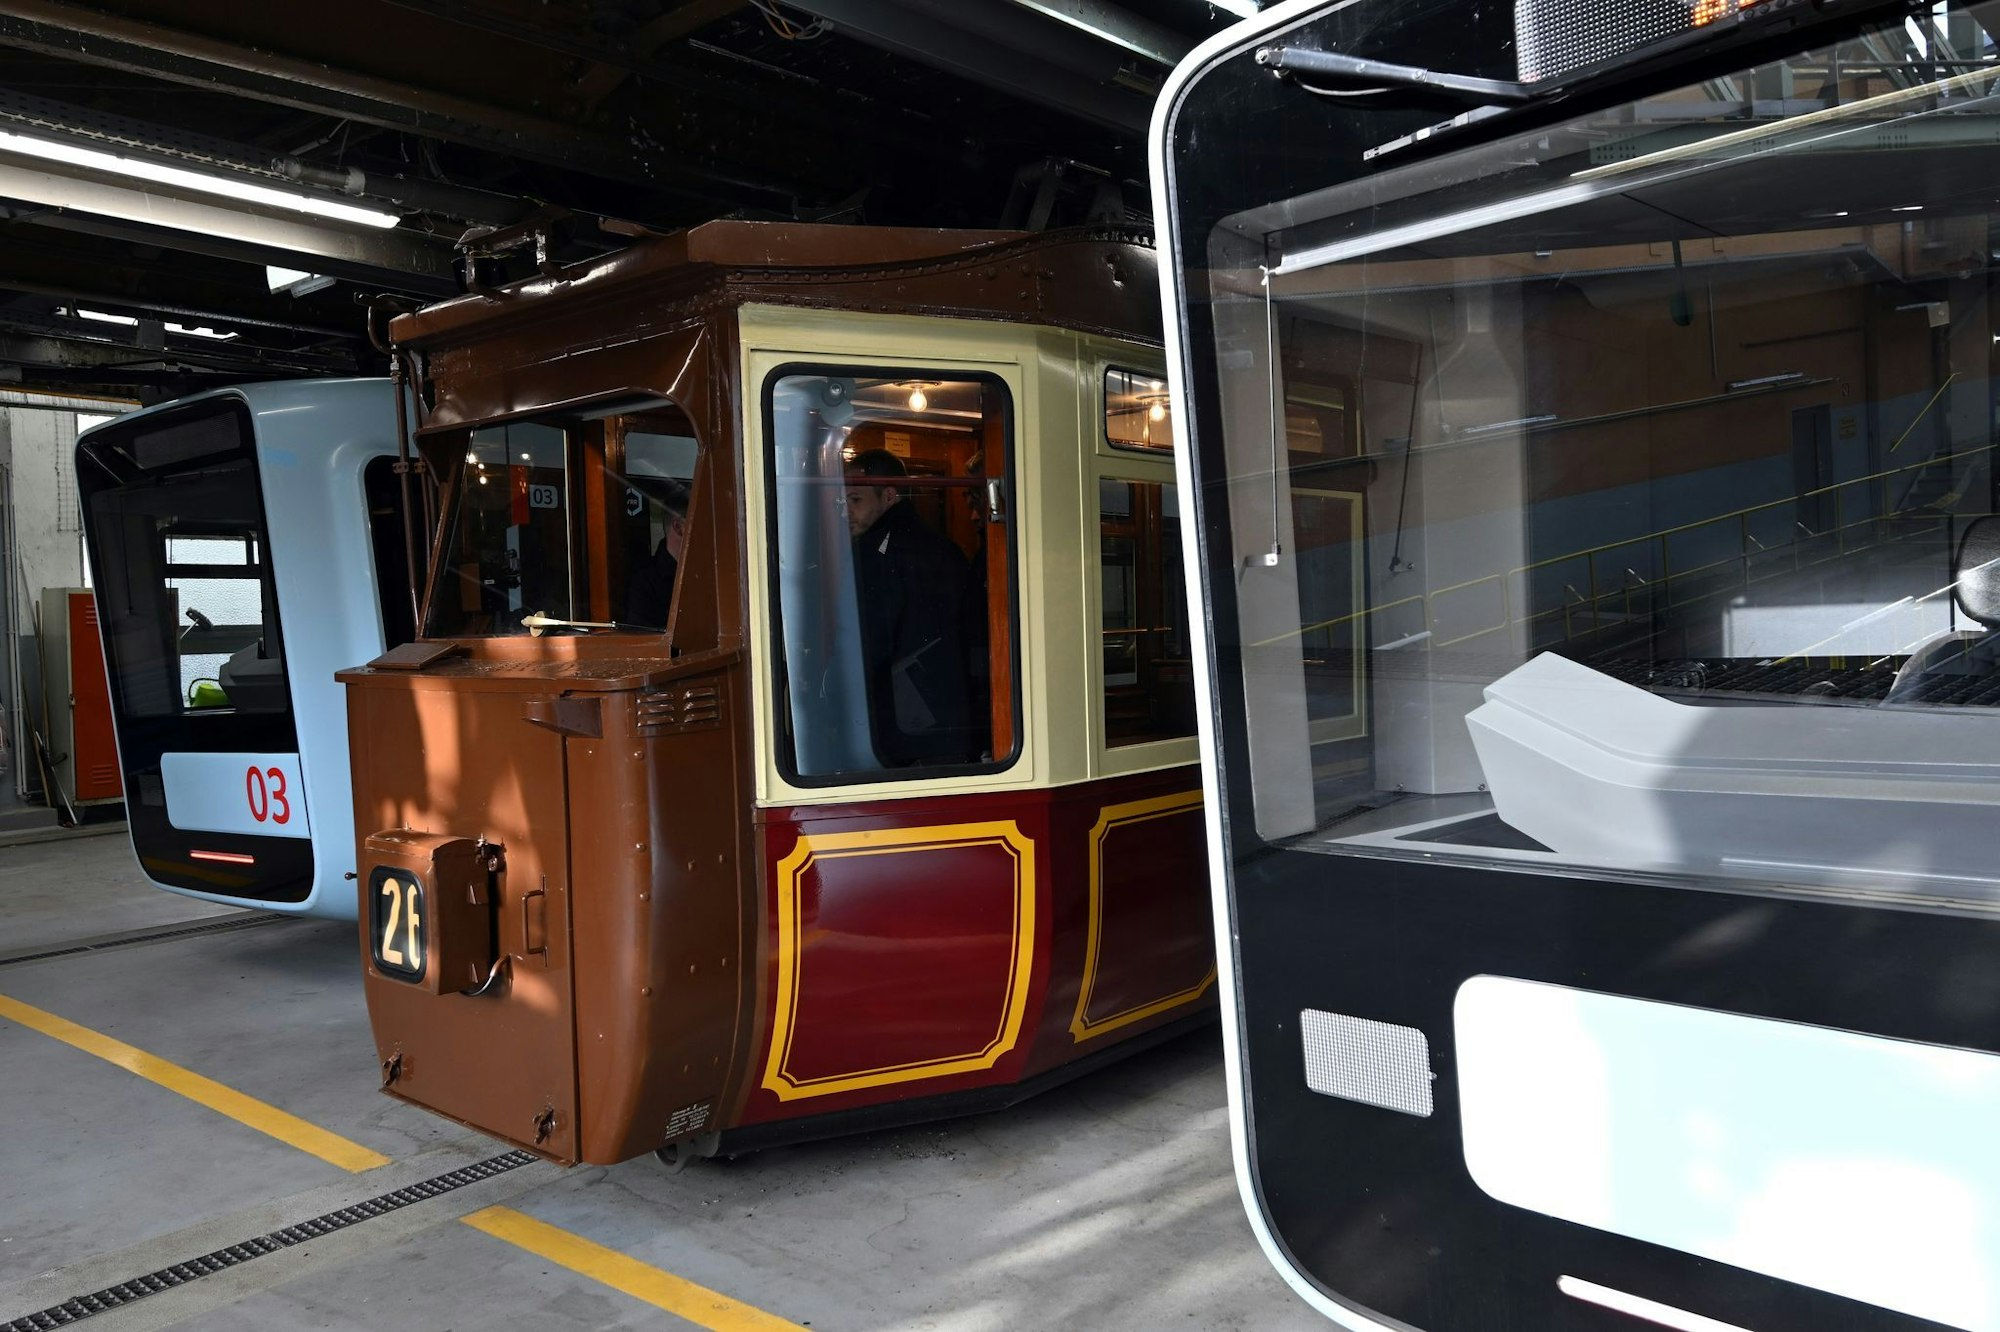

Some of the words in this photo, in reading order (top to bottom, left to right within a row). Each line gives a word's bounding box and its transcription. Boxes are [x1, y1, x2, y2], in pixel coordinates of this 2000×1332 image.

[533, 488, 553, 505] 03
[246, 766, 290, 824] 03
[382, 877, 420, 970] 26
